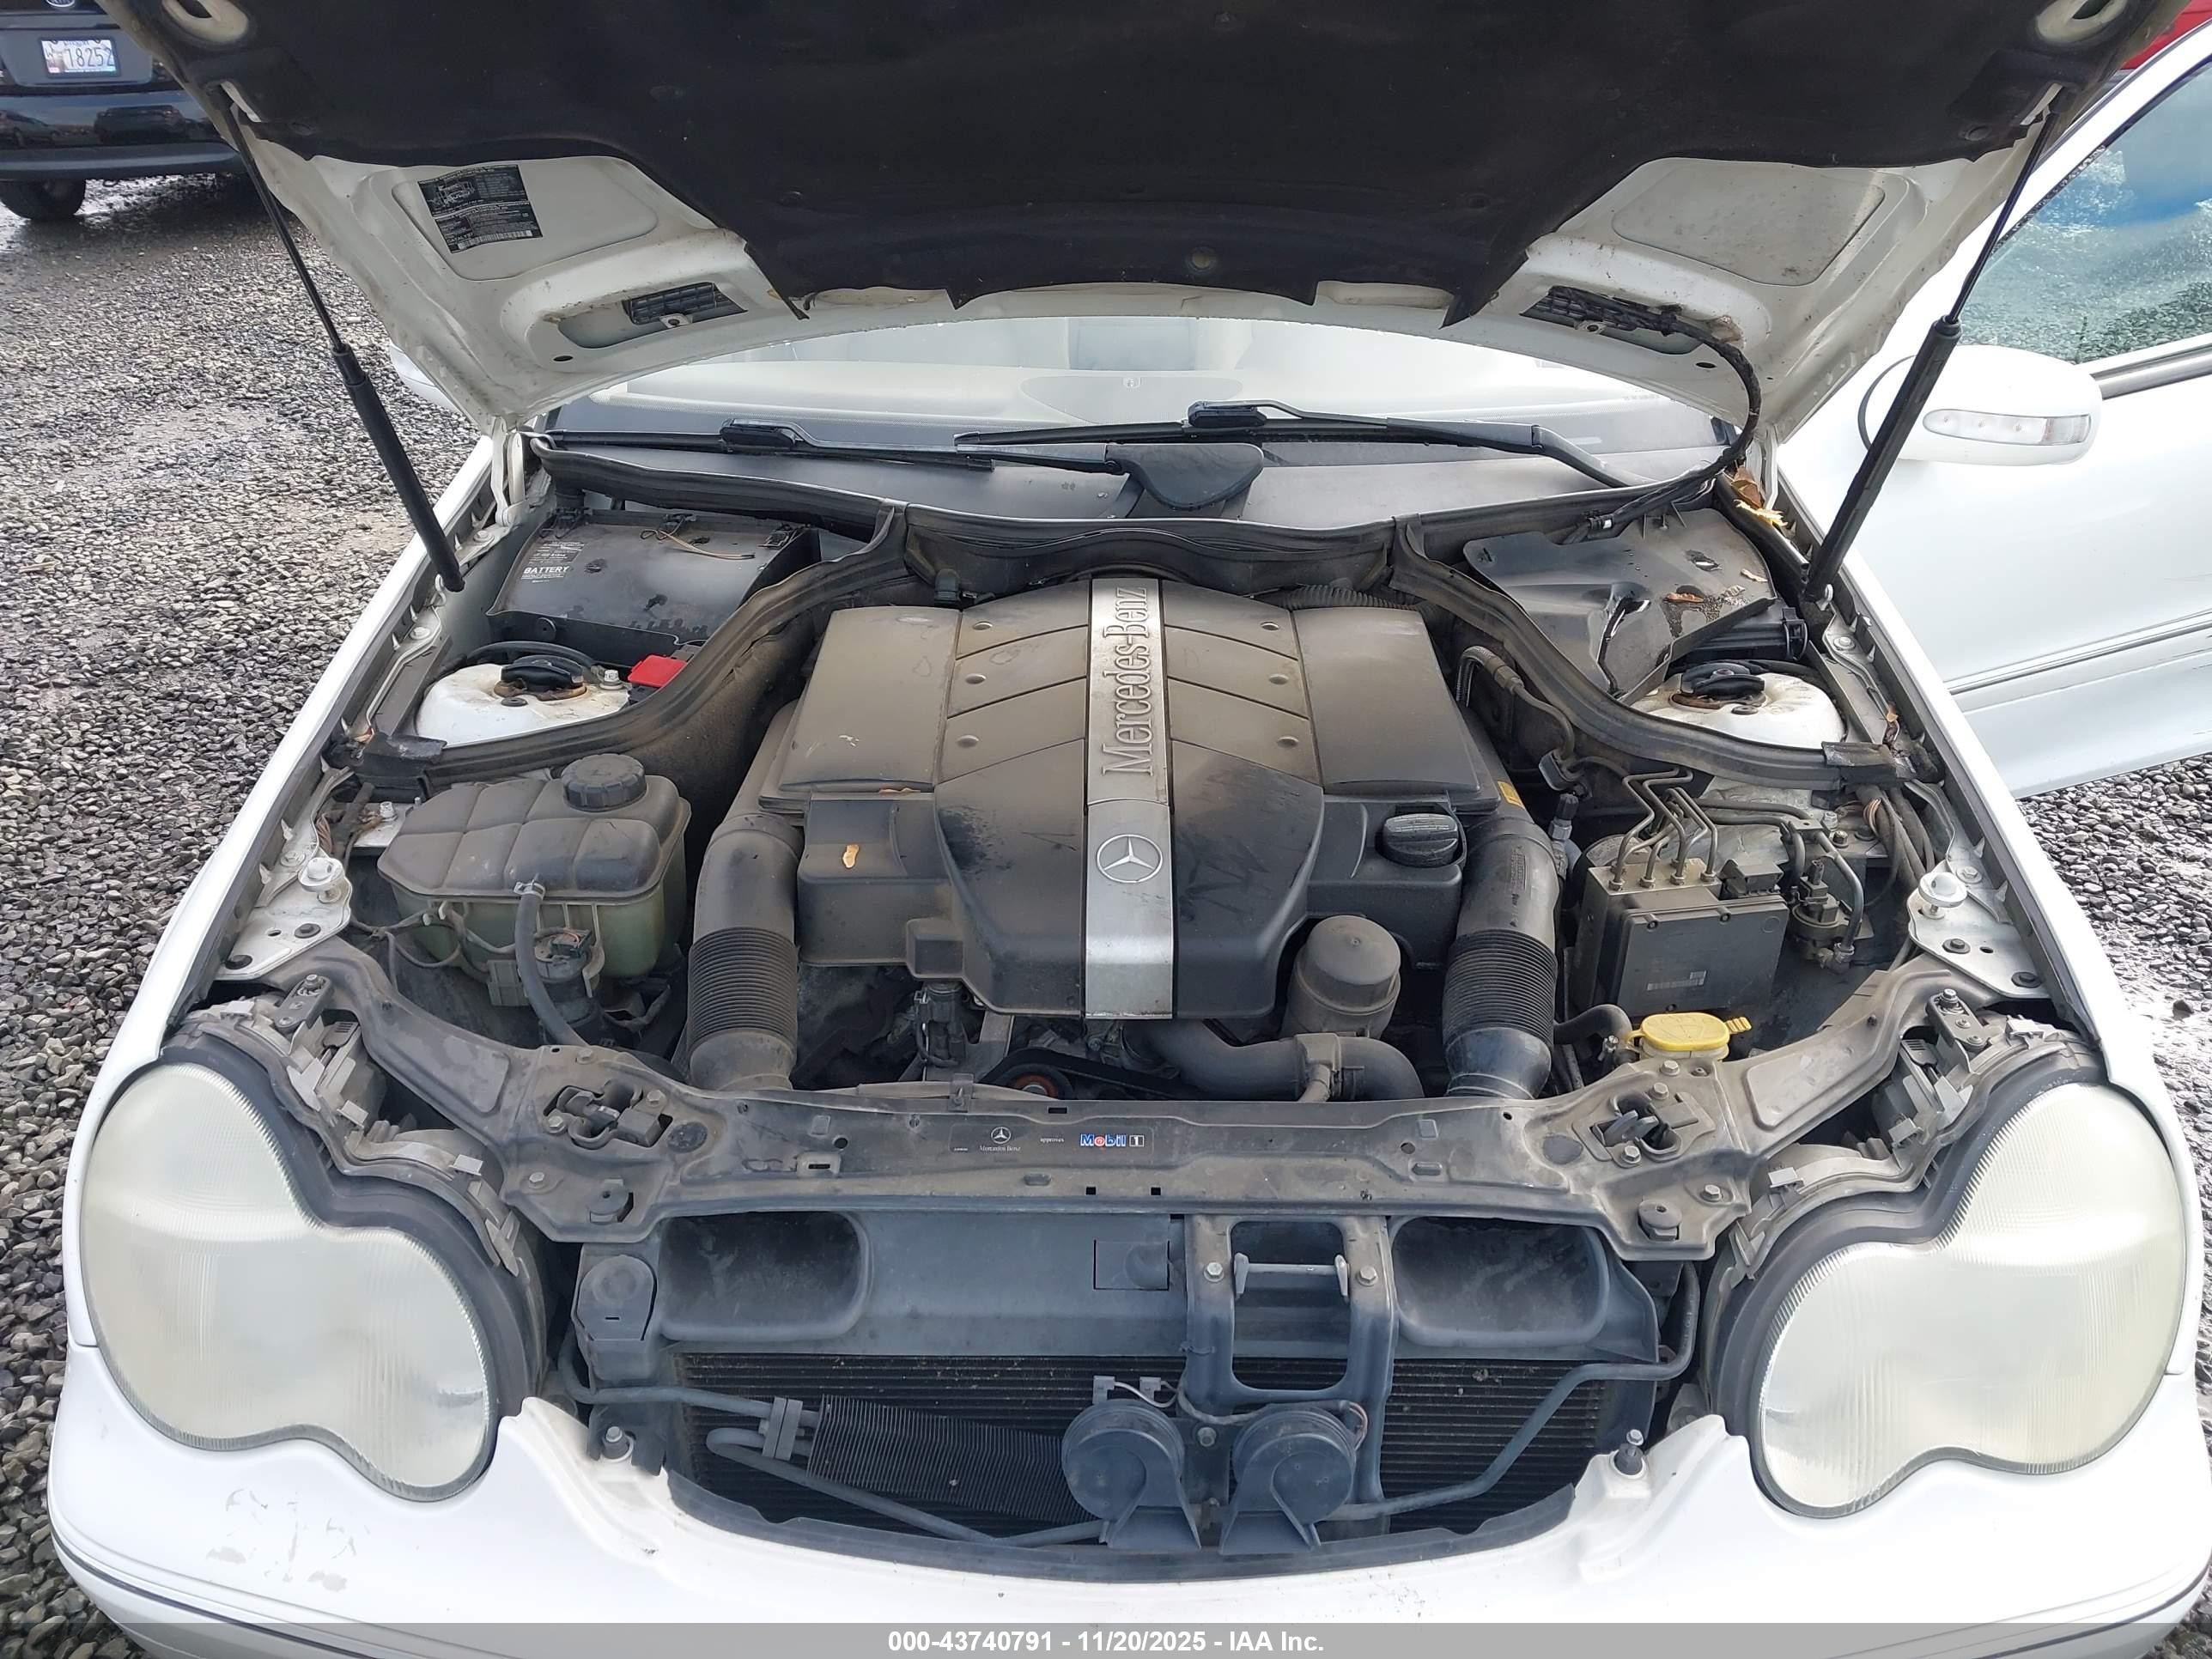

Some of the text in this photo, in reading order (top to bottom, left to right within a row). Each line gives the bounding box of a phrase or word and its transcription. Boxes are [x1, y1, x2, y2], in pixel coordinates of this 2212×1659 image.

[523, 565, 570, 574] BATTERY
[1101, 586, 1153, 777] Mercedes-Benz
[1079, 1133, 1127, 1147] Mobil
